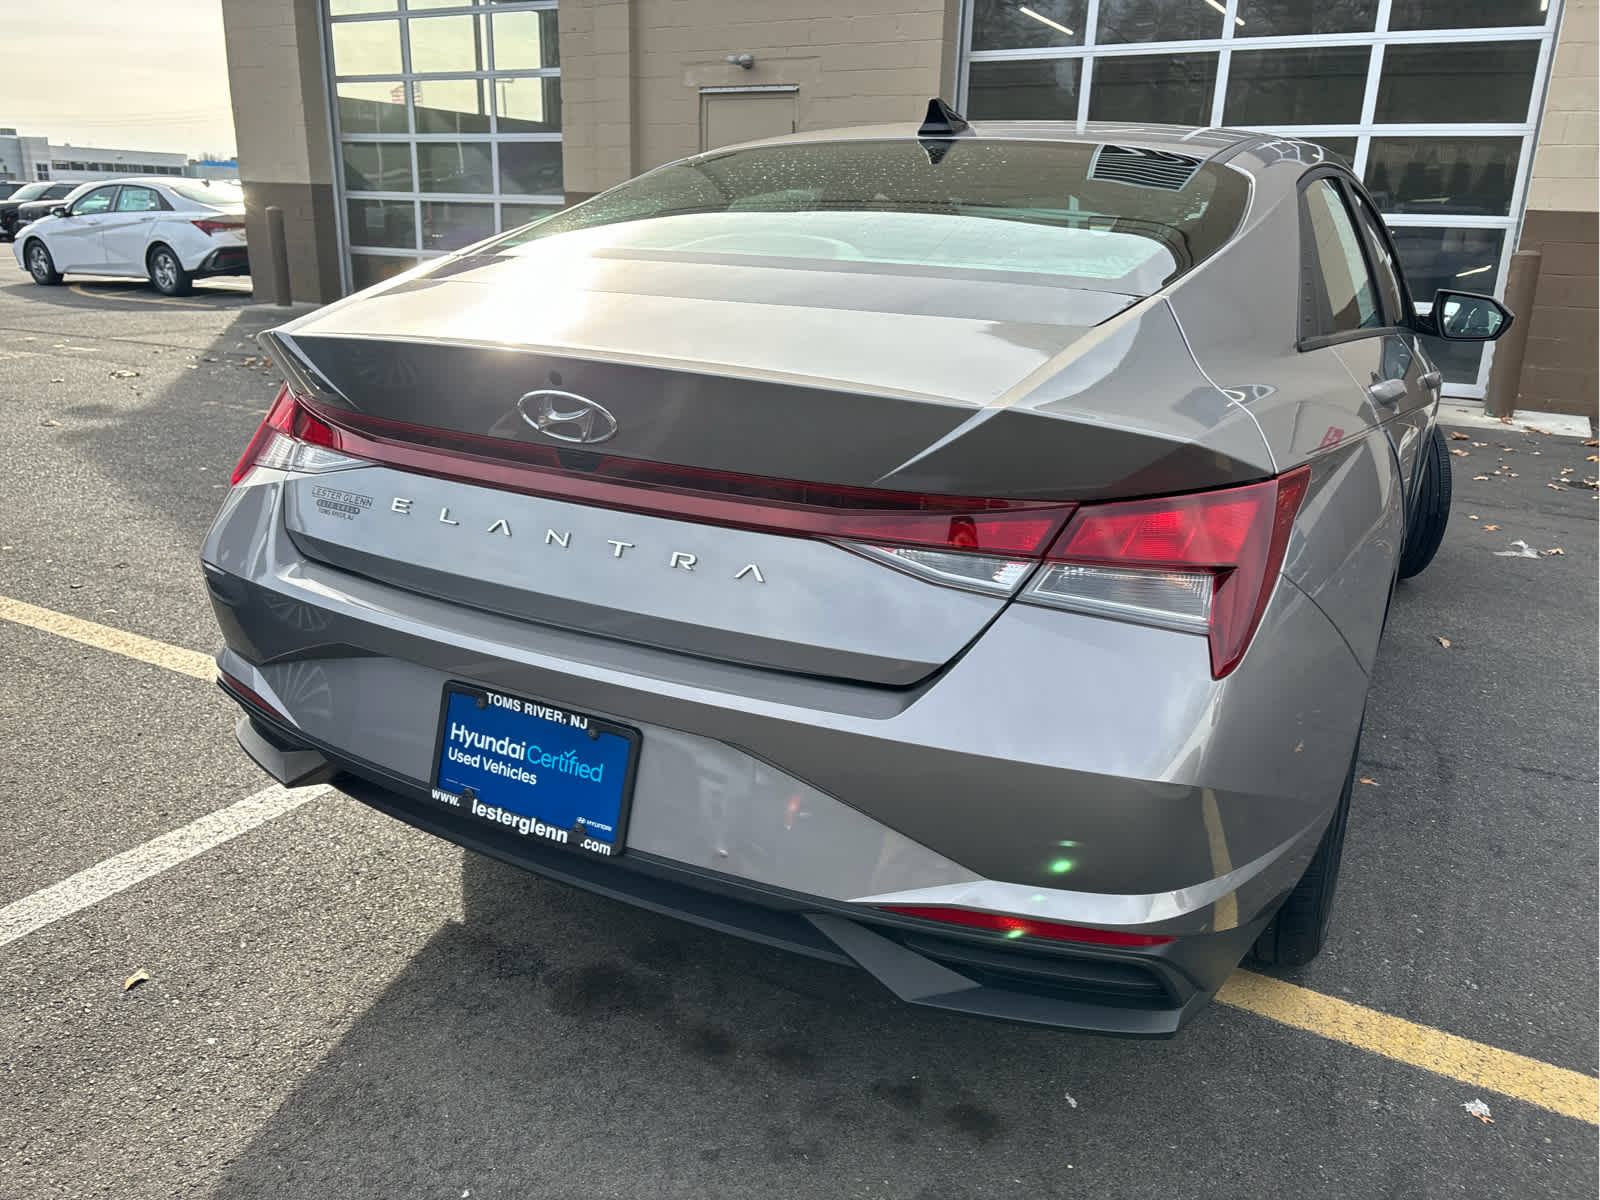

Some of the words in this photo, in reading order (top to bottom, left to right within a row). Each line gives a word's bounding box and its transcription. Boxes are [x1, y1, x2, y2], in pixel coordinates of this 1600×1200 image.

[311, 486, 342, 500] LESTER
[343, 494, 373, 507] GLENN
[391, 497, 765, 583] ELANTRA
[486, 692, 521, 712] TOMS
[524, 703, 567, 724] RIVER,
[570, 715, 588, 729] NJ
[448, 746, 481, 768] Used
[482, 757, 537, 785] Vehicles
[450, 722, 526, 760] Hyundai
[527, 745, 603, 783] Certified
[431, 788, 460, 807] www.
[472, 799, 568, 843] lesterglenn
[580, 837, 611, 856] .com
